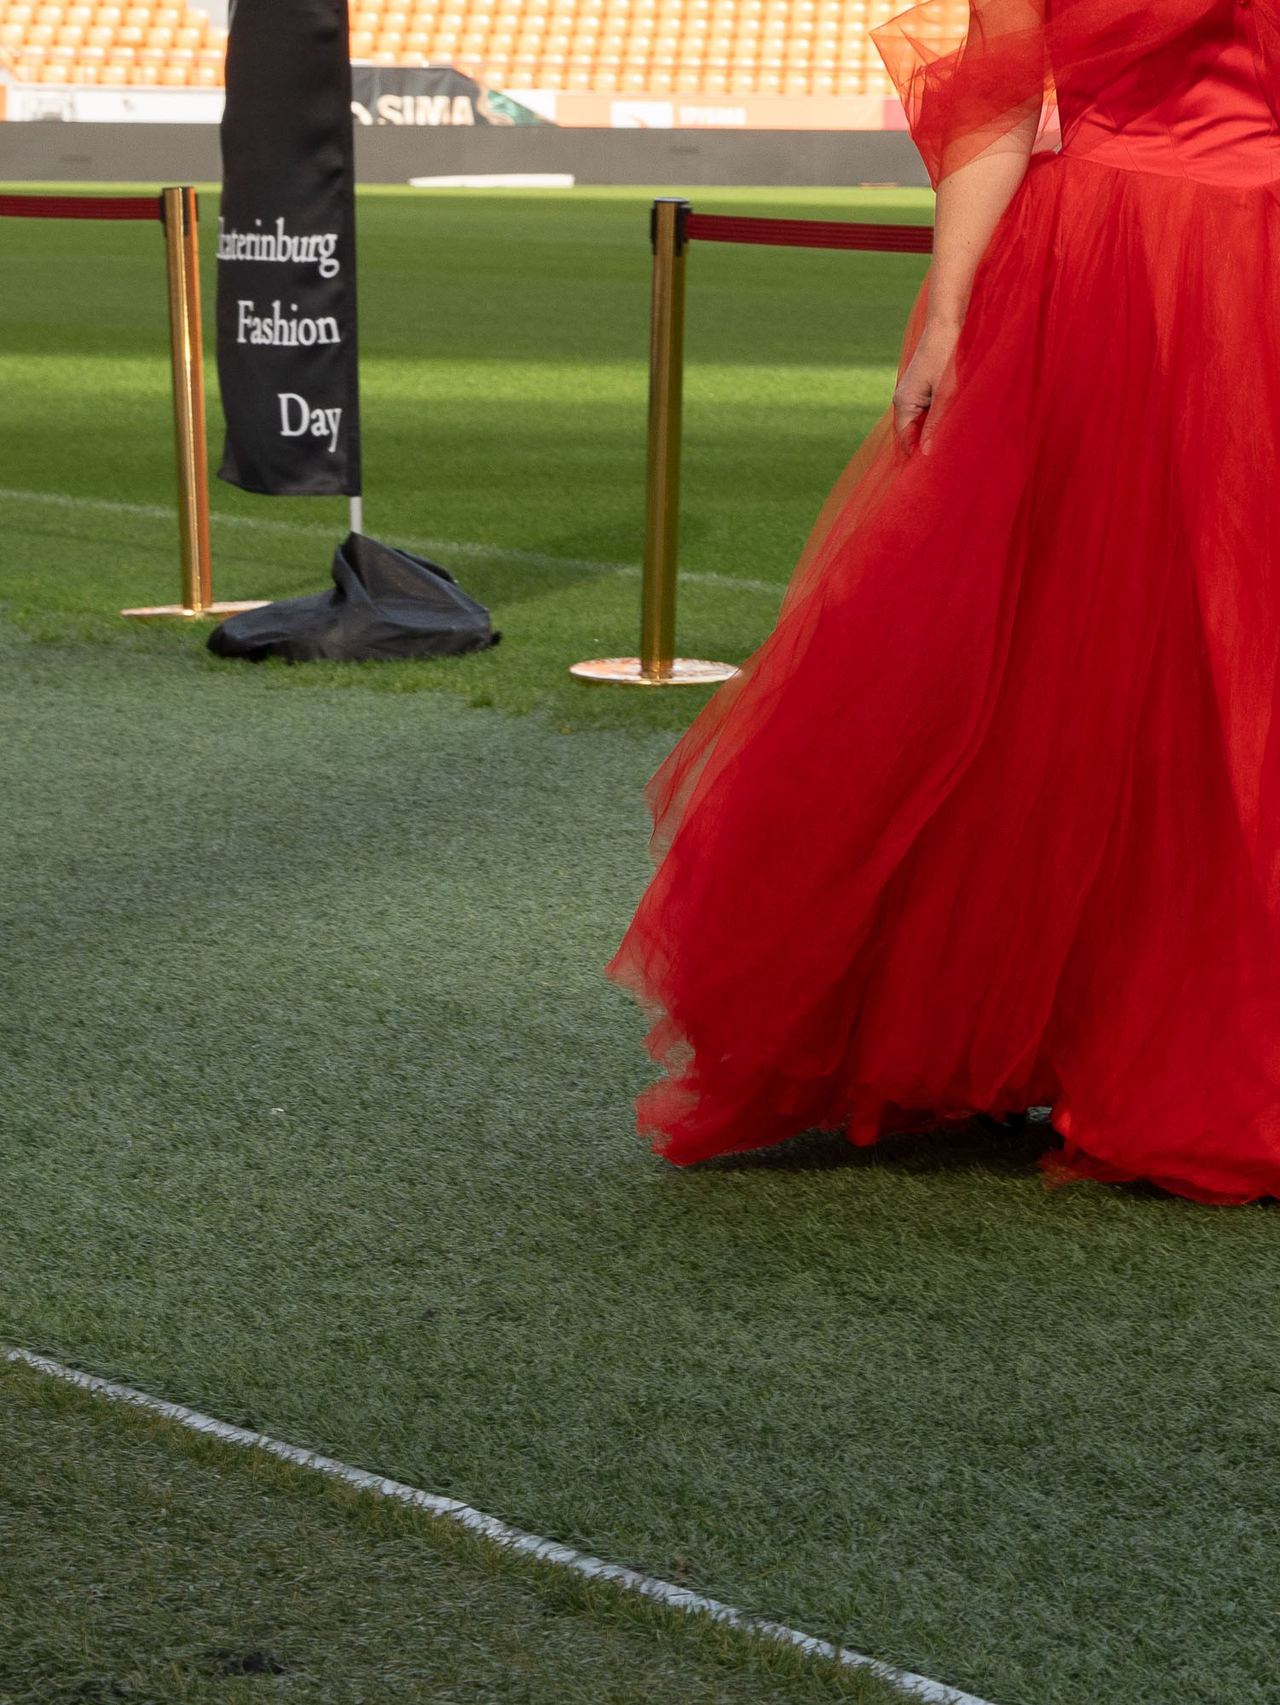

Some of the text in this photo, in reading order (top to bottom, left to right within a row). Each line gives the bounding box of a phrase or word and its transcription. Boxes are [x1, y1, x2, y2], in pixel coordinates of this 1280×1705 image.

[376, 93, 475, 126] SIMA
[236, 299, 341, 346] Fashion
[277, 392, 342, 453] Day
